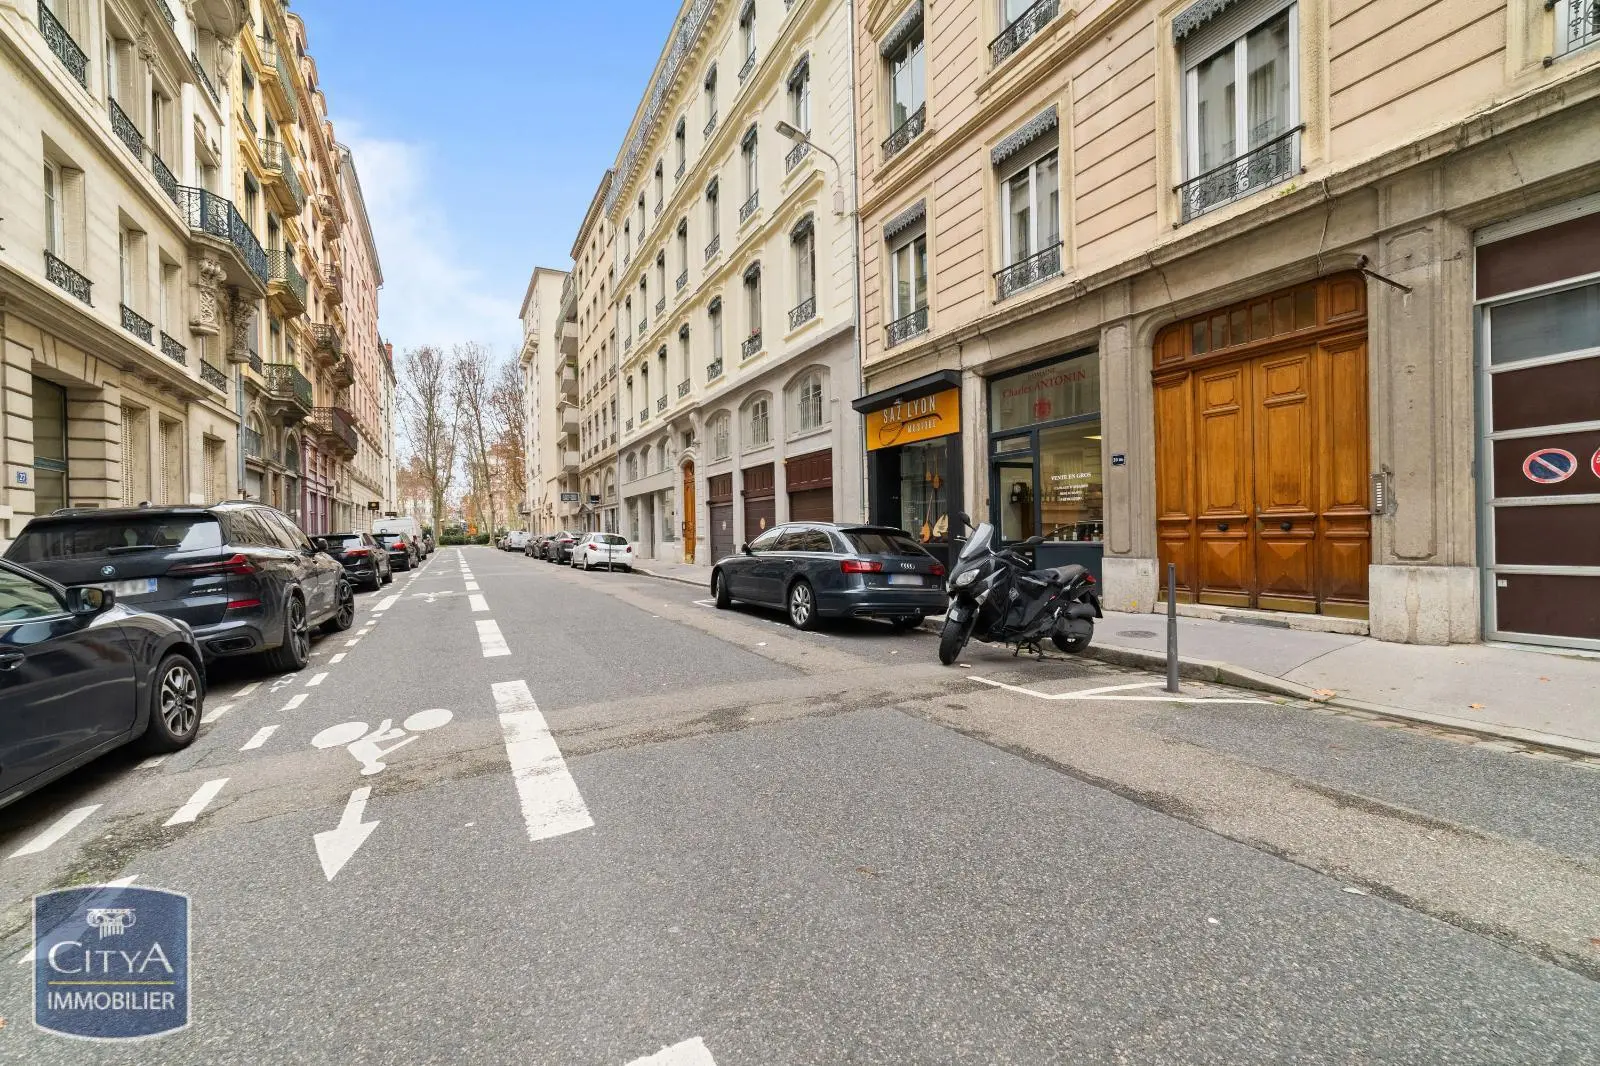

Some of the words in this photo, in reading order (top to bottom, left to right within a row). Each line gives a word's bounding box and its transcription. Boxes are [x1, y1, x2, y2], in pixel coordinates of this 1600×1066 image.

[1002, 384, 1032, 400] Charles
[1034, 369, 1086, 391] ANTONIN
[883, 405, 902, 424] SAZ
[907, 394, 936, 418] LYON
